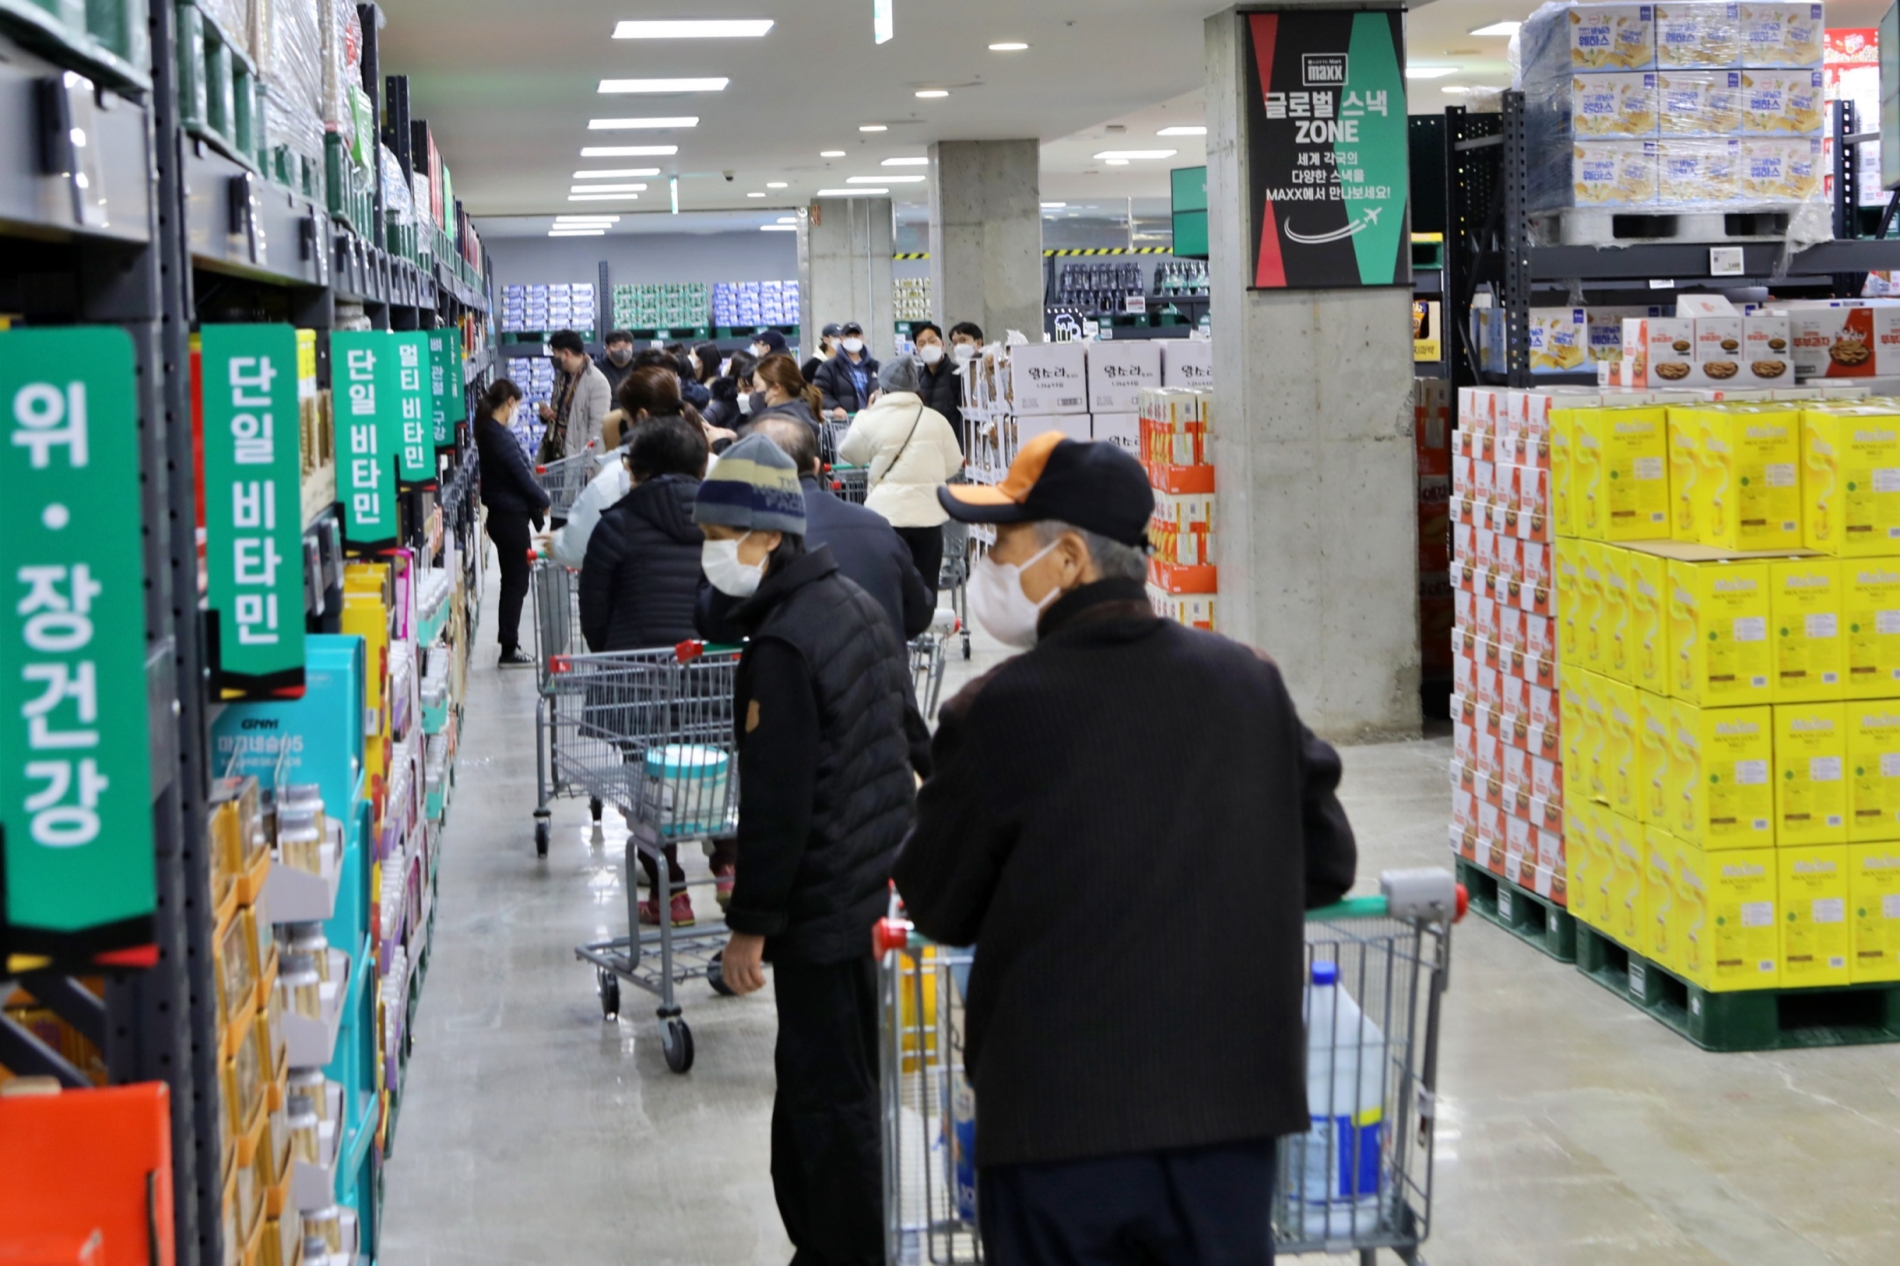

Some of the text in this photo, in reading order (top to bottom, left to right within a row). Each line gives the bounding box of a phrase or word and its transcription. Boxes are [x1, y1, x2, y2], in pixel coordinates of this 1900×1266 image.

[1308, 65, 1342, 81] maxx
[1265, 90, 1388, 119] 글로벌 스낵
[1295, 120, 1360, 144] ZONE
[1297, 152, 1358, 166] 세계 각국의
[1291, 169, 1364, 184] 다양한 스낵을
[1266, 186, 1391, 201] MAXX에서 만나보세요!
[399, 344, 424, 469] 멀티 비타민
[1615, 419, 1655, 432] Maxim
[1746, 422, 1788, 438] Maxim
[348, 349, 381, 524] 단일 비타민
[1854, 426, 1896, 442] Maxim
[228, 356, 282, 644] 단일 비타민
[1714, 575, 1757, 591] Maxim
[1787, 571, 1829, 587] Maxim
[1857, 567, 1900, 584] Maxim
[1716, 718, 1759, 734] Maxim
[1791, 714, 1834, 731] Maxim
[1722, 860, 1765, 876] Maxim
[1794, 856, 1837, 872] Maxim
